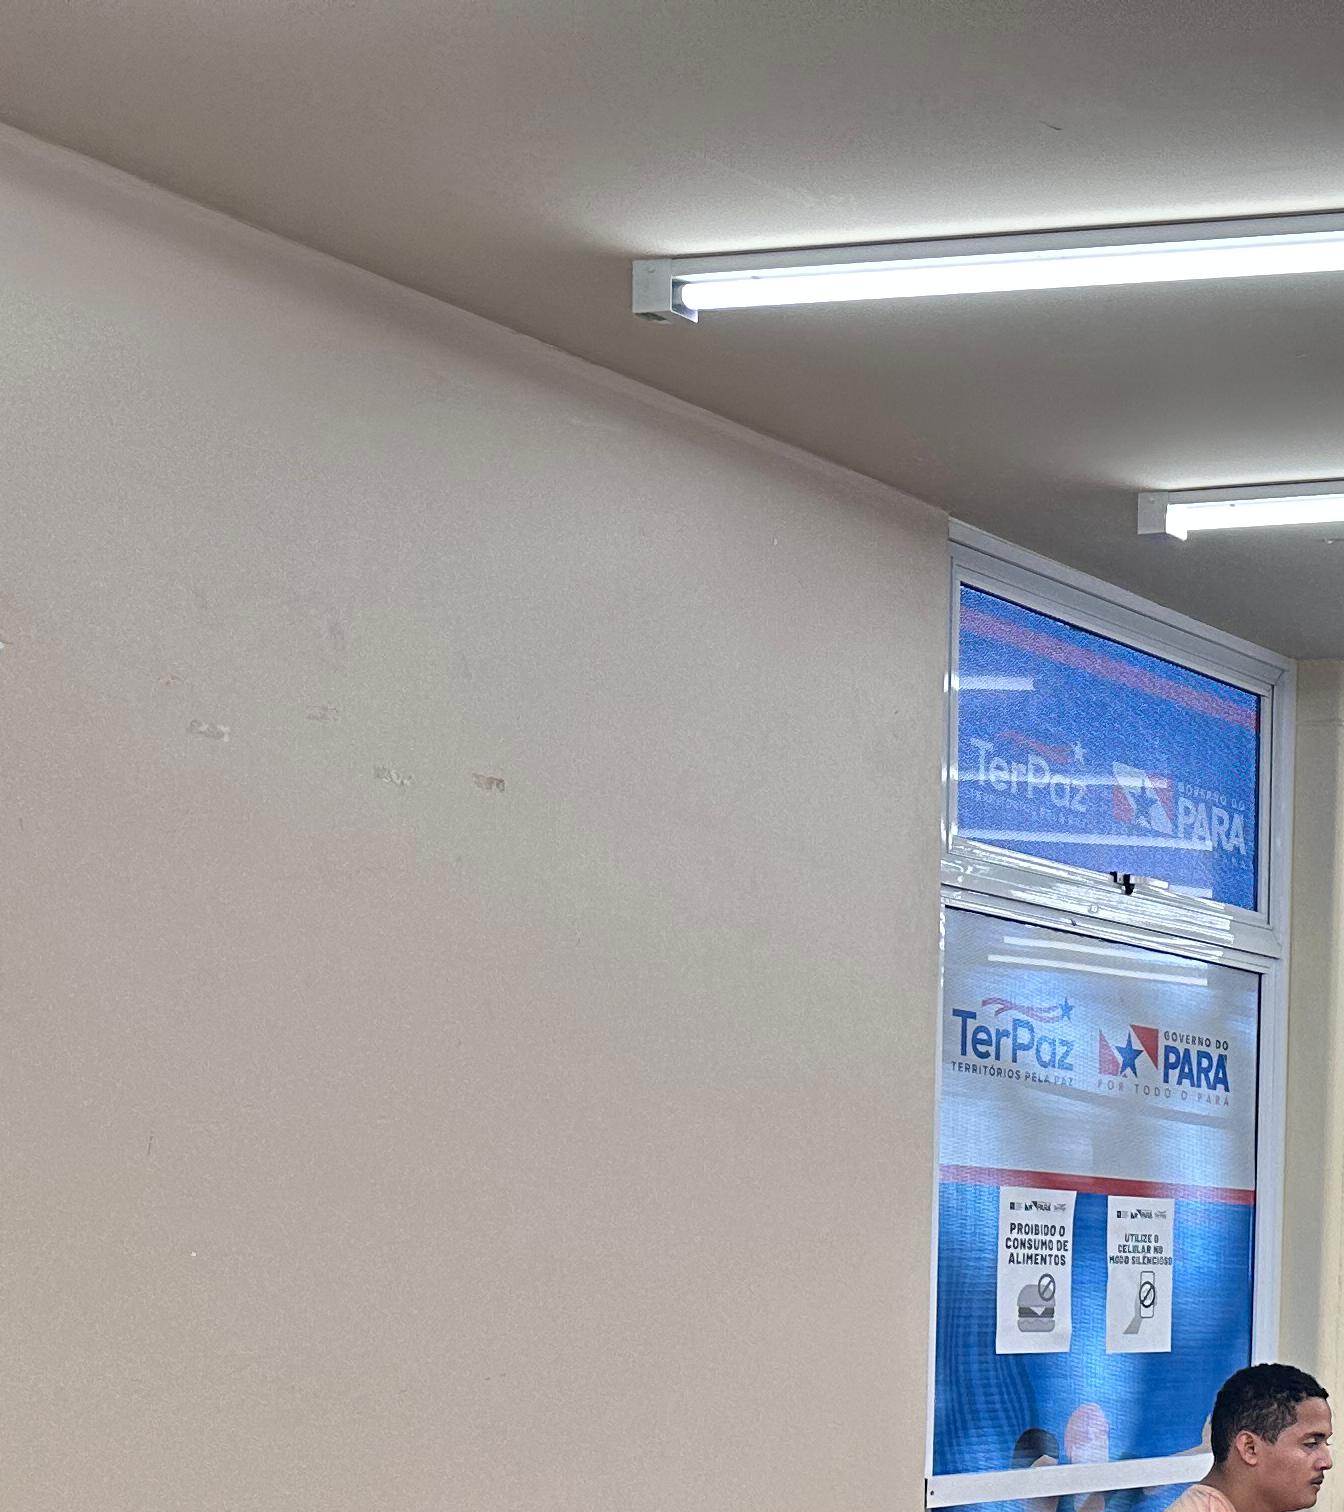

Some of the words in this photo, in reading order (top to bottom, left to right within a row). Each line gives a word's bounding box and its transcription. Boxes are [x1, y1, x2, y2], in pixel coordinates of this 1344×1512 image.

[970, 738, 1088, 813] TerPaz
[952, 1008, 1073, 1071] TerPaz
[1163, 1030, 1211, 1047] GOVERNO
[1215, 1039, 1229, 1051] DO
[952, 1061, 1020, 1080] TERRITÓRIOS
[1134, 1083, 1172, 1099] TODO
[1009, 1222, 1056, 1237] PROIBIDO
[1059, 1224, 1066, 1237] O
[1005, 1237, 1054, 1251] CONSUMO
[1056, 1239, 1069, 1252] DE
[1124, 1233, 1152, 1244] UTILIZE
[1117, 1244, 1151, 1254] CELULAR
[1008, 1252, 1066, 1266] ALIMENTOS
